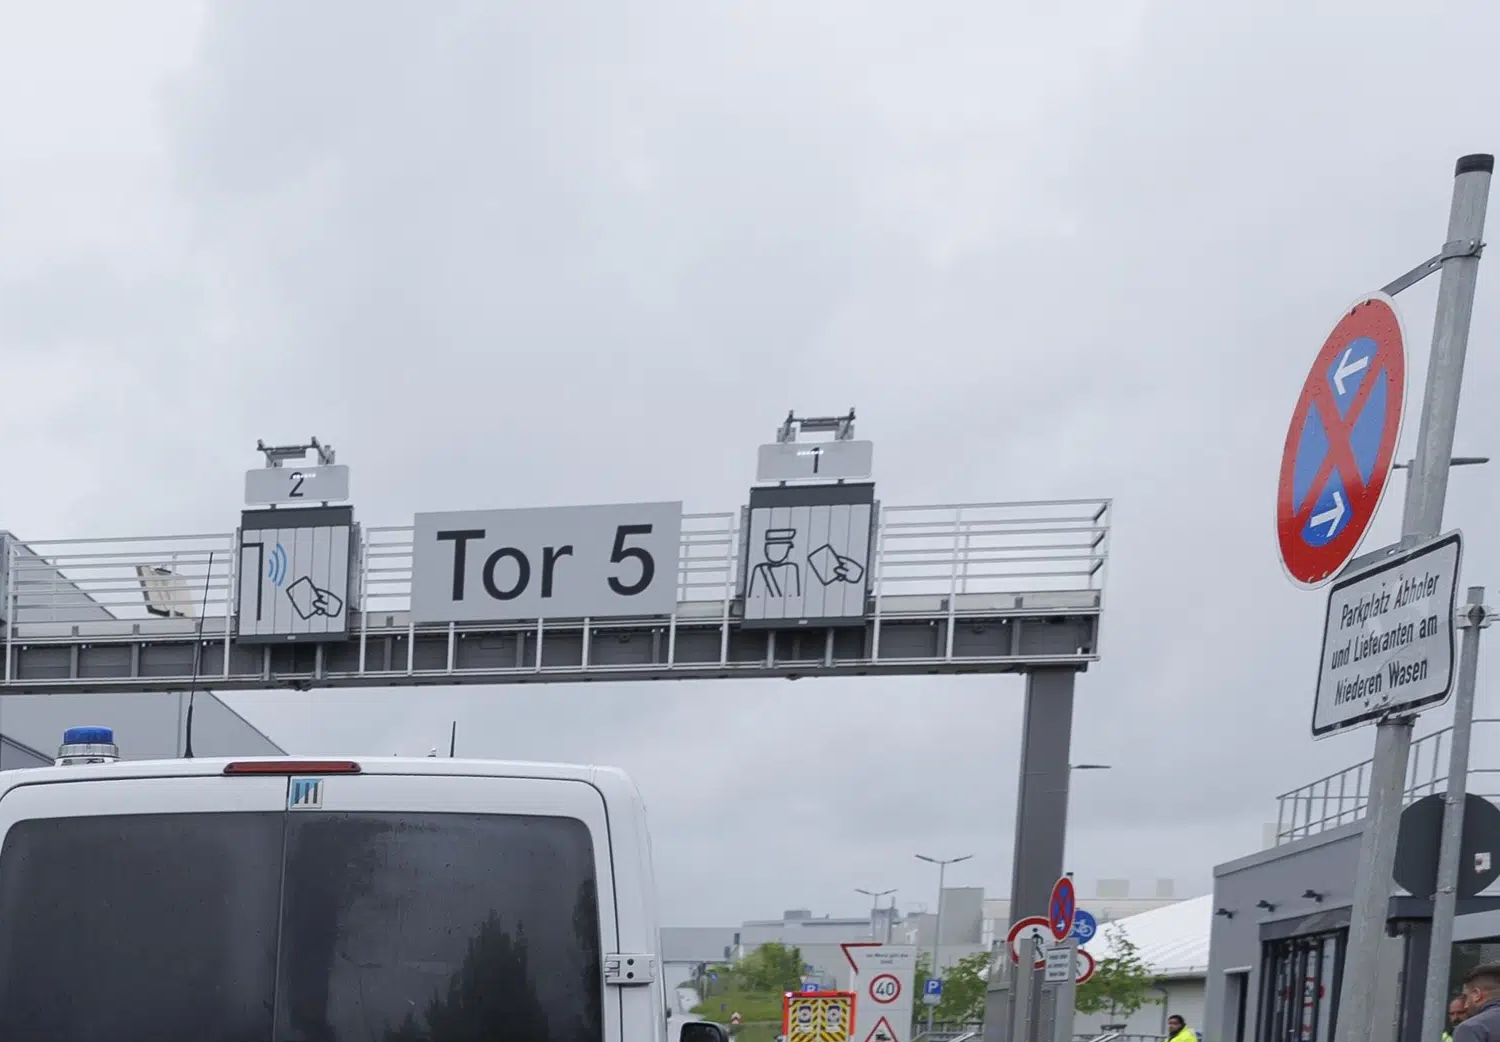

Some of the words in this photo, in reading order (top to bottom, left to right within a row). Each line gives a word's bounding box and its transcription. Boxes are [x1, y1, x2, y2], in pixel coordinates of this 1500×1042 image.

[810, 446, 820, 474] 1
[288, 471, 304, 498] 2
[436, 528, 574, 601] Tor
[607, 523, 655, 597] 5
[1340, 593, 1391, 630] Parkplatz
[1394, 572, 1440, 610] Abholer
[1331, 637, 1352, 670] und
[1353, 622, 1415, 663] Lieferanten
[1419, 613, 1438, 639] am
[1334, 671, 1382, 707] Niederen
[1388, 657, 1428, 689] Wasen
[875, 981, 895, 997] 40
[927, 980, 940, 993] P
